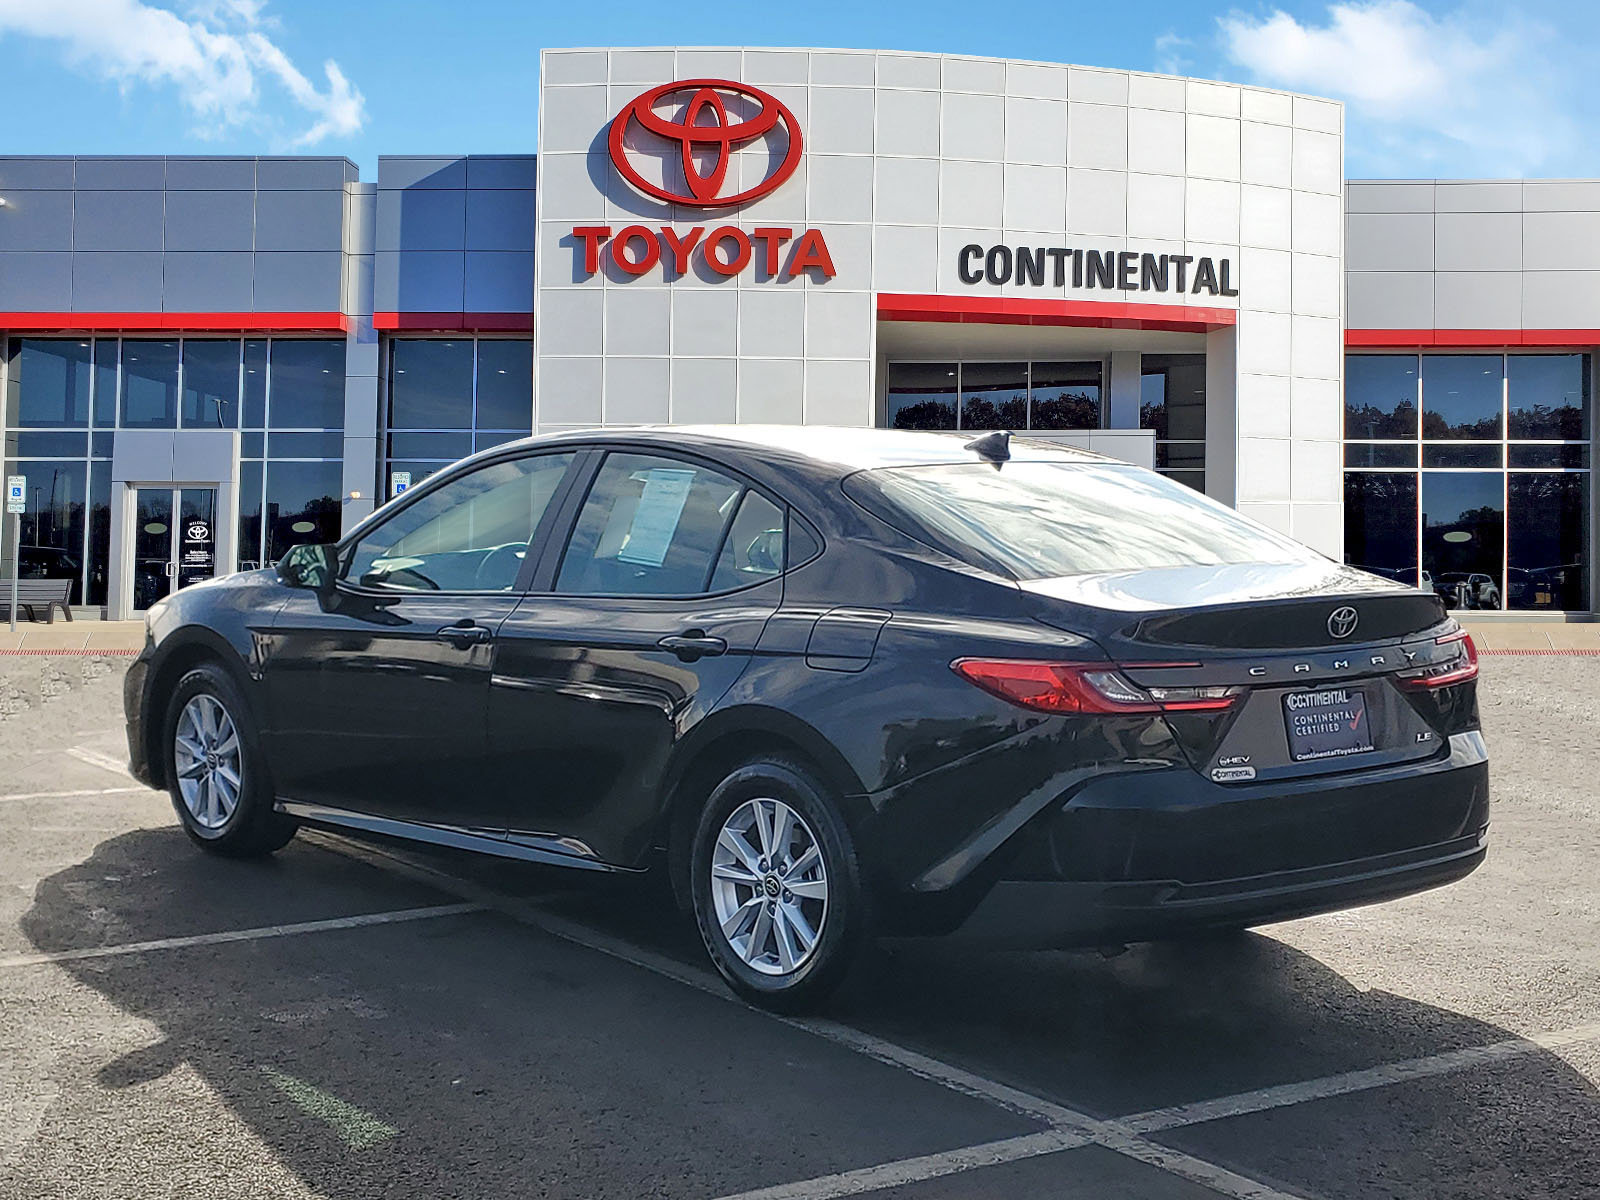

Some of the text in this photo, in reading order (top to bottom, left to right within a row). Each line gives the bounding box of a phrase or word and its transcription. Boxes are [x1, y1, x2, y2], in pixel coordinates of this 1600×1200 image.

[573, 225, 836, 277] TOYOTA
[958, 244, 1239, 297] CONTINENTAL
[1249, 652, 1416, 676] CAMRY
[1294, 710, 1355, 725] CONTINENTAL
[1296, 723, 1340, 736] CERTIFIED
[1416, 732, 1432, 742] LE
[1296, 745, 1375, 760] ContinentalToyota.com
